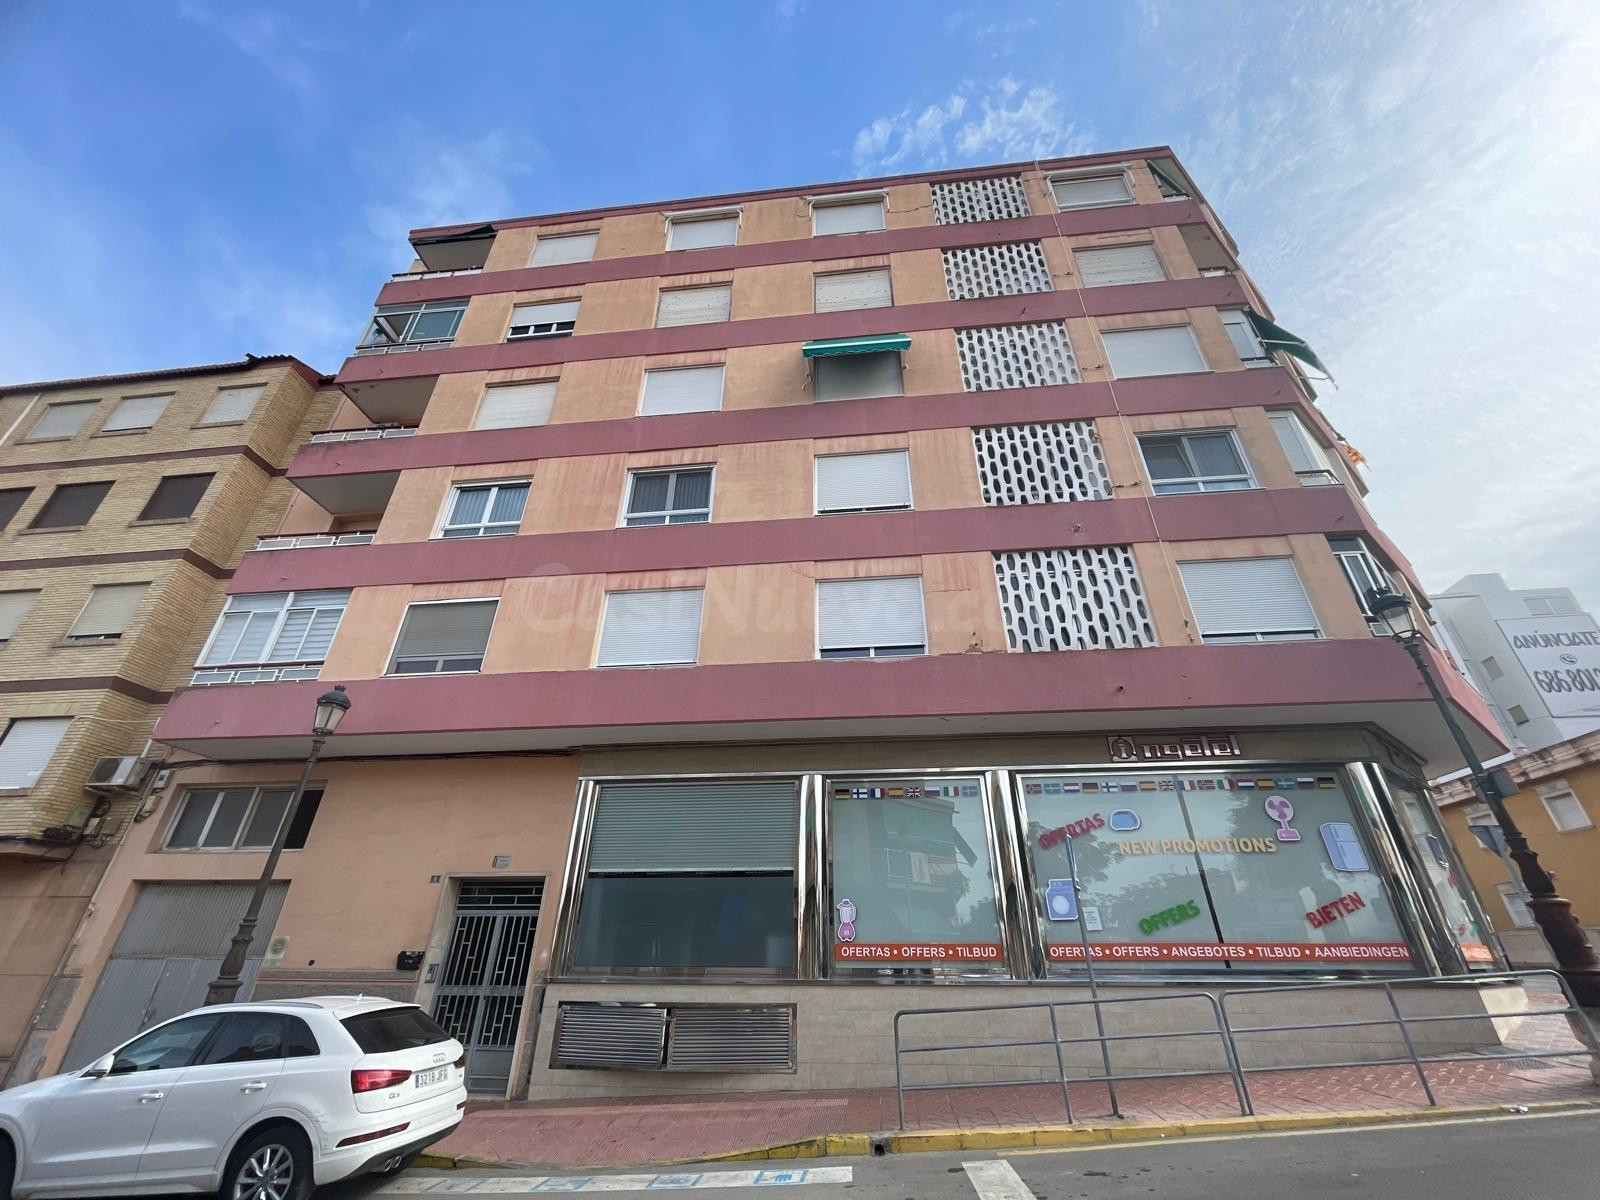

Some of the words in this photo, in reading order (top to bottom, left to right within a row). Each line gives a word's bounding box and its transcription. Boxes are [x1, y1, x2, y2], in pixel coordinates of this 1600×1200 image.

[1039, 813, 1105, 849] OFERTAS
[1119, 839, 1158, 855] NEW
[1162, 836, 1278, 855] PROMOTIONS
[1138, 899, 1201, 936] OFFERS
[1305, 891, 1367, 929] BIETEN
[841, 946, 890, 957] OFERTAS
[901, 946, 946, 958] OFFERS
[956, 946, 997, 957] TILBUD
[1050, 946, 1102, 957] OFERTAS
[1112, 946, 1160, 957] OFFERS
[1171, 946, 1246, 957] ANGEBOTES
[1256, 946, 1301, 958] TILBUD
[1315, 946, 1409, 958] AANBIEDINGEN
